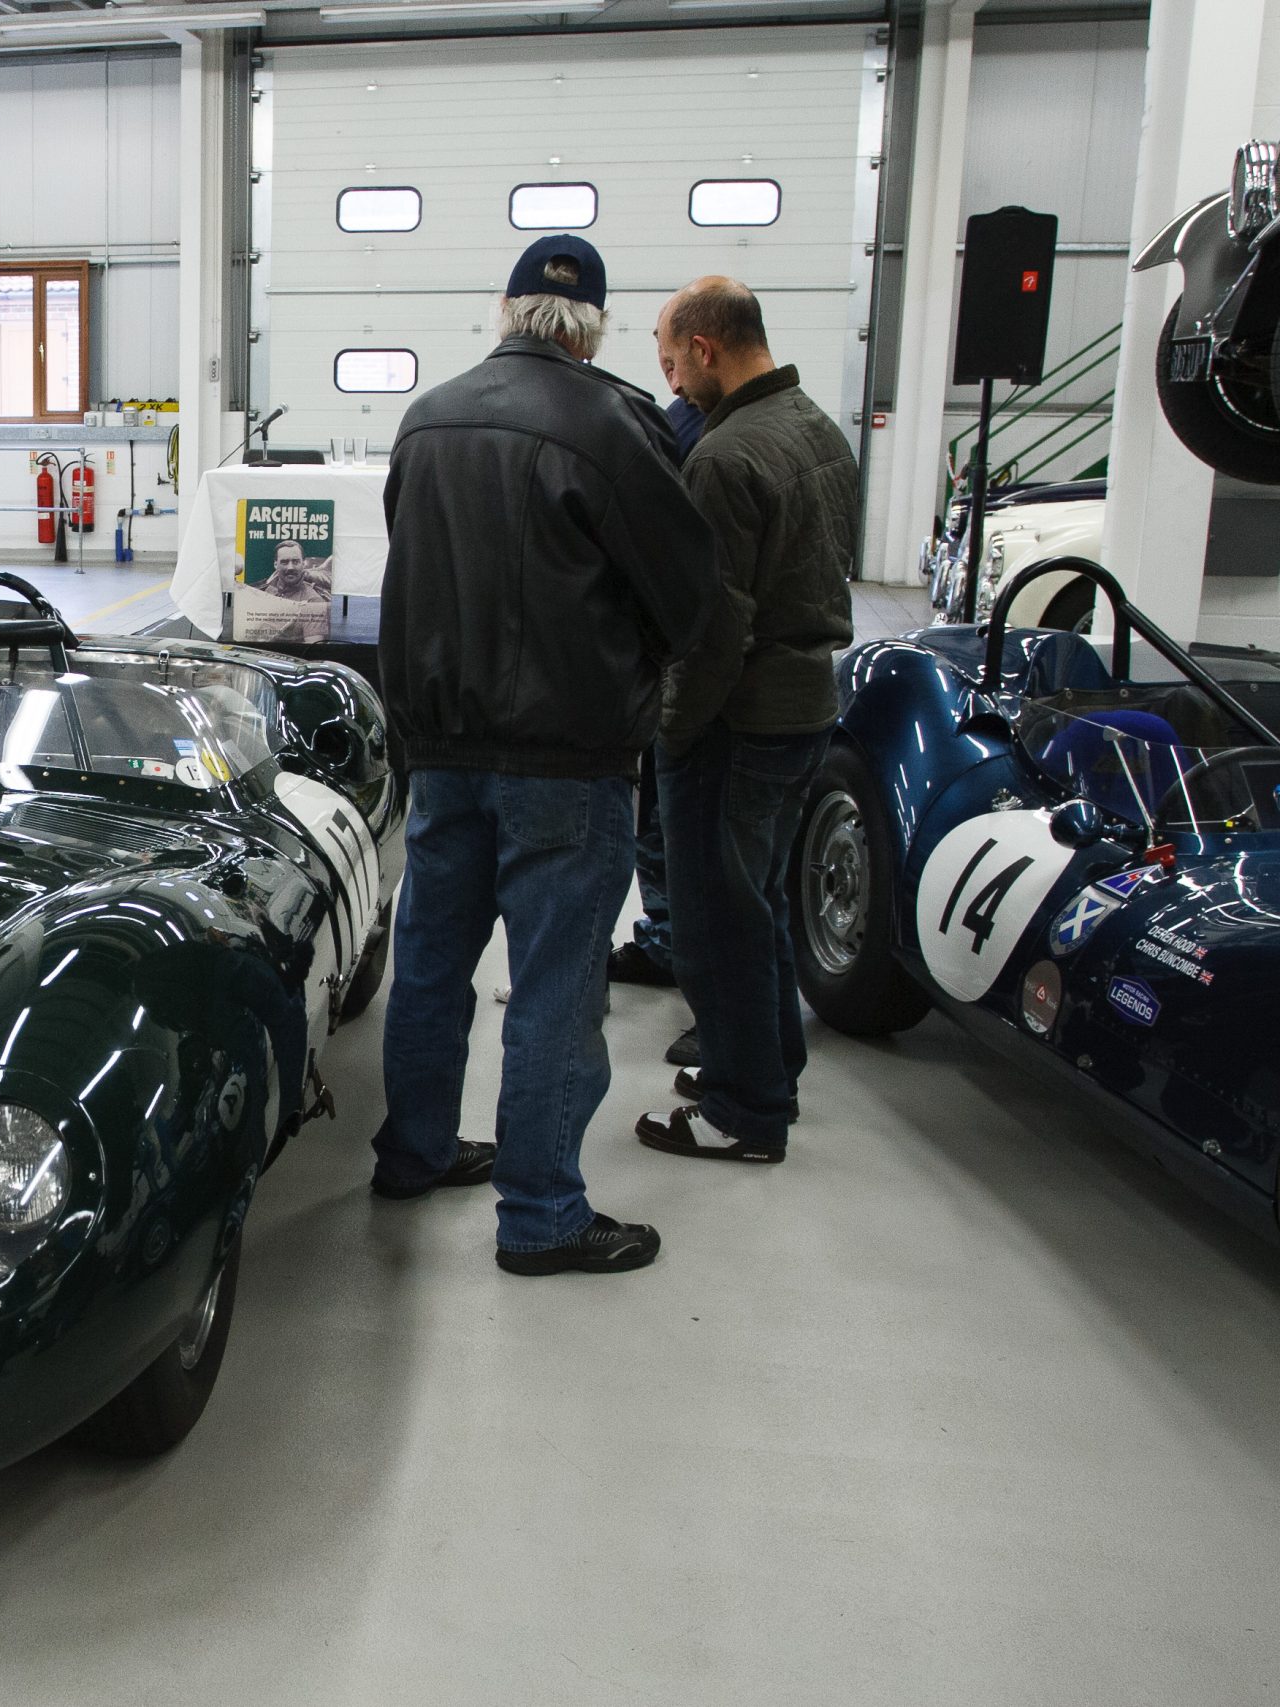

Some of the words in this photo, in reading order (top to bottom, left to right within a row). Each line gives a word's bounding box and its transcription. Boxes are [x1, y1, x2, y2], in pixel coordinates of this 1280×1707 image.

[248, 506, 308, 523] ARCHIE
[308, 513, 330, 523] AND
[248, 530, 265, 540] THE
[266, 523, 329, 541] LISTERS
[938, 837, 1035, 956] 14
[1147, 925, 1176, 946] DEREK
[1171, 934, 1197, 955] HOOD
[1135, 938, 1162, 958] CHRIS
[1157, 949, 1201, 979] BUNCOMBE
[1110, 985, 1153, 1020] LEGENDS
